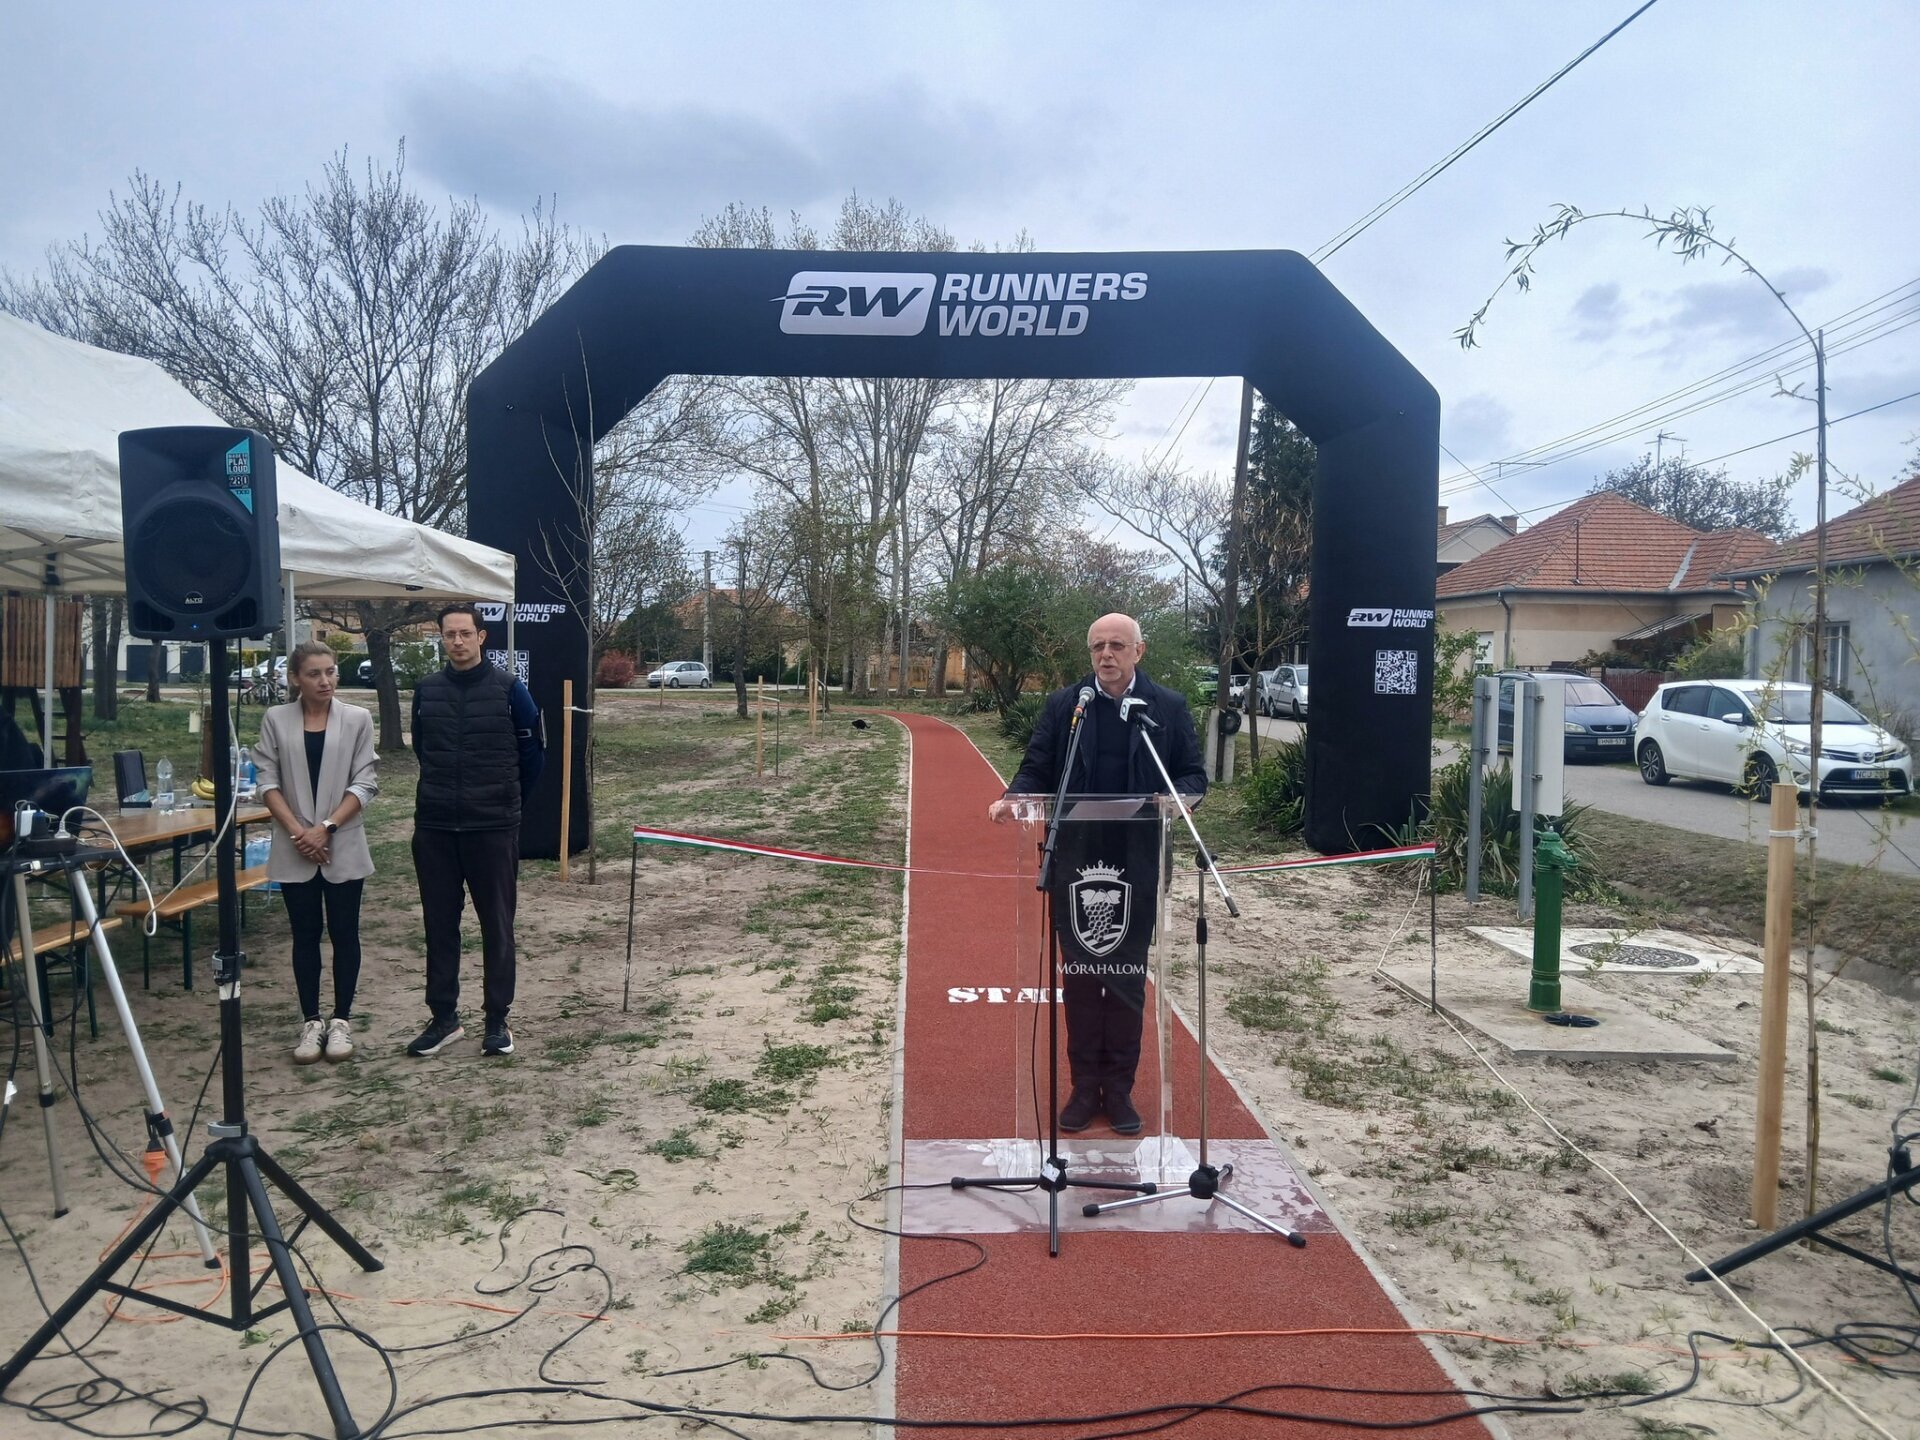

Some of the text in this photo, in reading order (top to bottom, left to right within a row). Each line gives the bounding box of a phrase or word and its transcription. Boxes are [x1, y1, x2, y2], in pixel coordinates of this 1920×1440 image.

[941, 272, 1149, 301] RUNNERS
[939, 305, 1089, 337] WORLD
[228, 458, 248, 466] PLAY
[229, 465, 248, 473] LOUD
[229, 475, 249, 486] 280
[512, 603, 566, 613] UNNERS
[1393, 608, 1434, 619] RUNNERS
[1392, 618, 1427, 628] WORLD
[1056, 961, 1146, 975] MÓRAHALOM
[947, 987, 1065, 1004] STA
